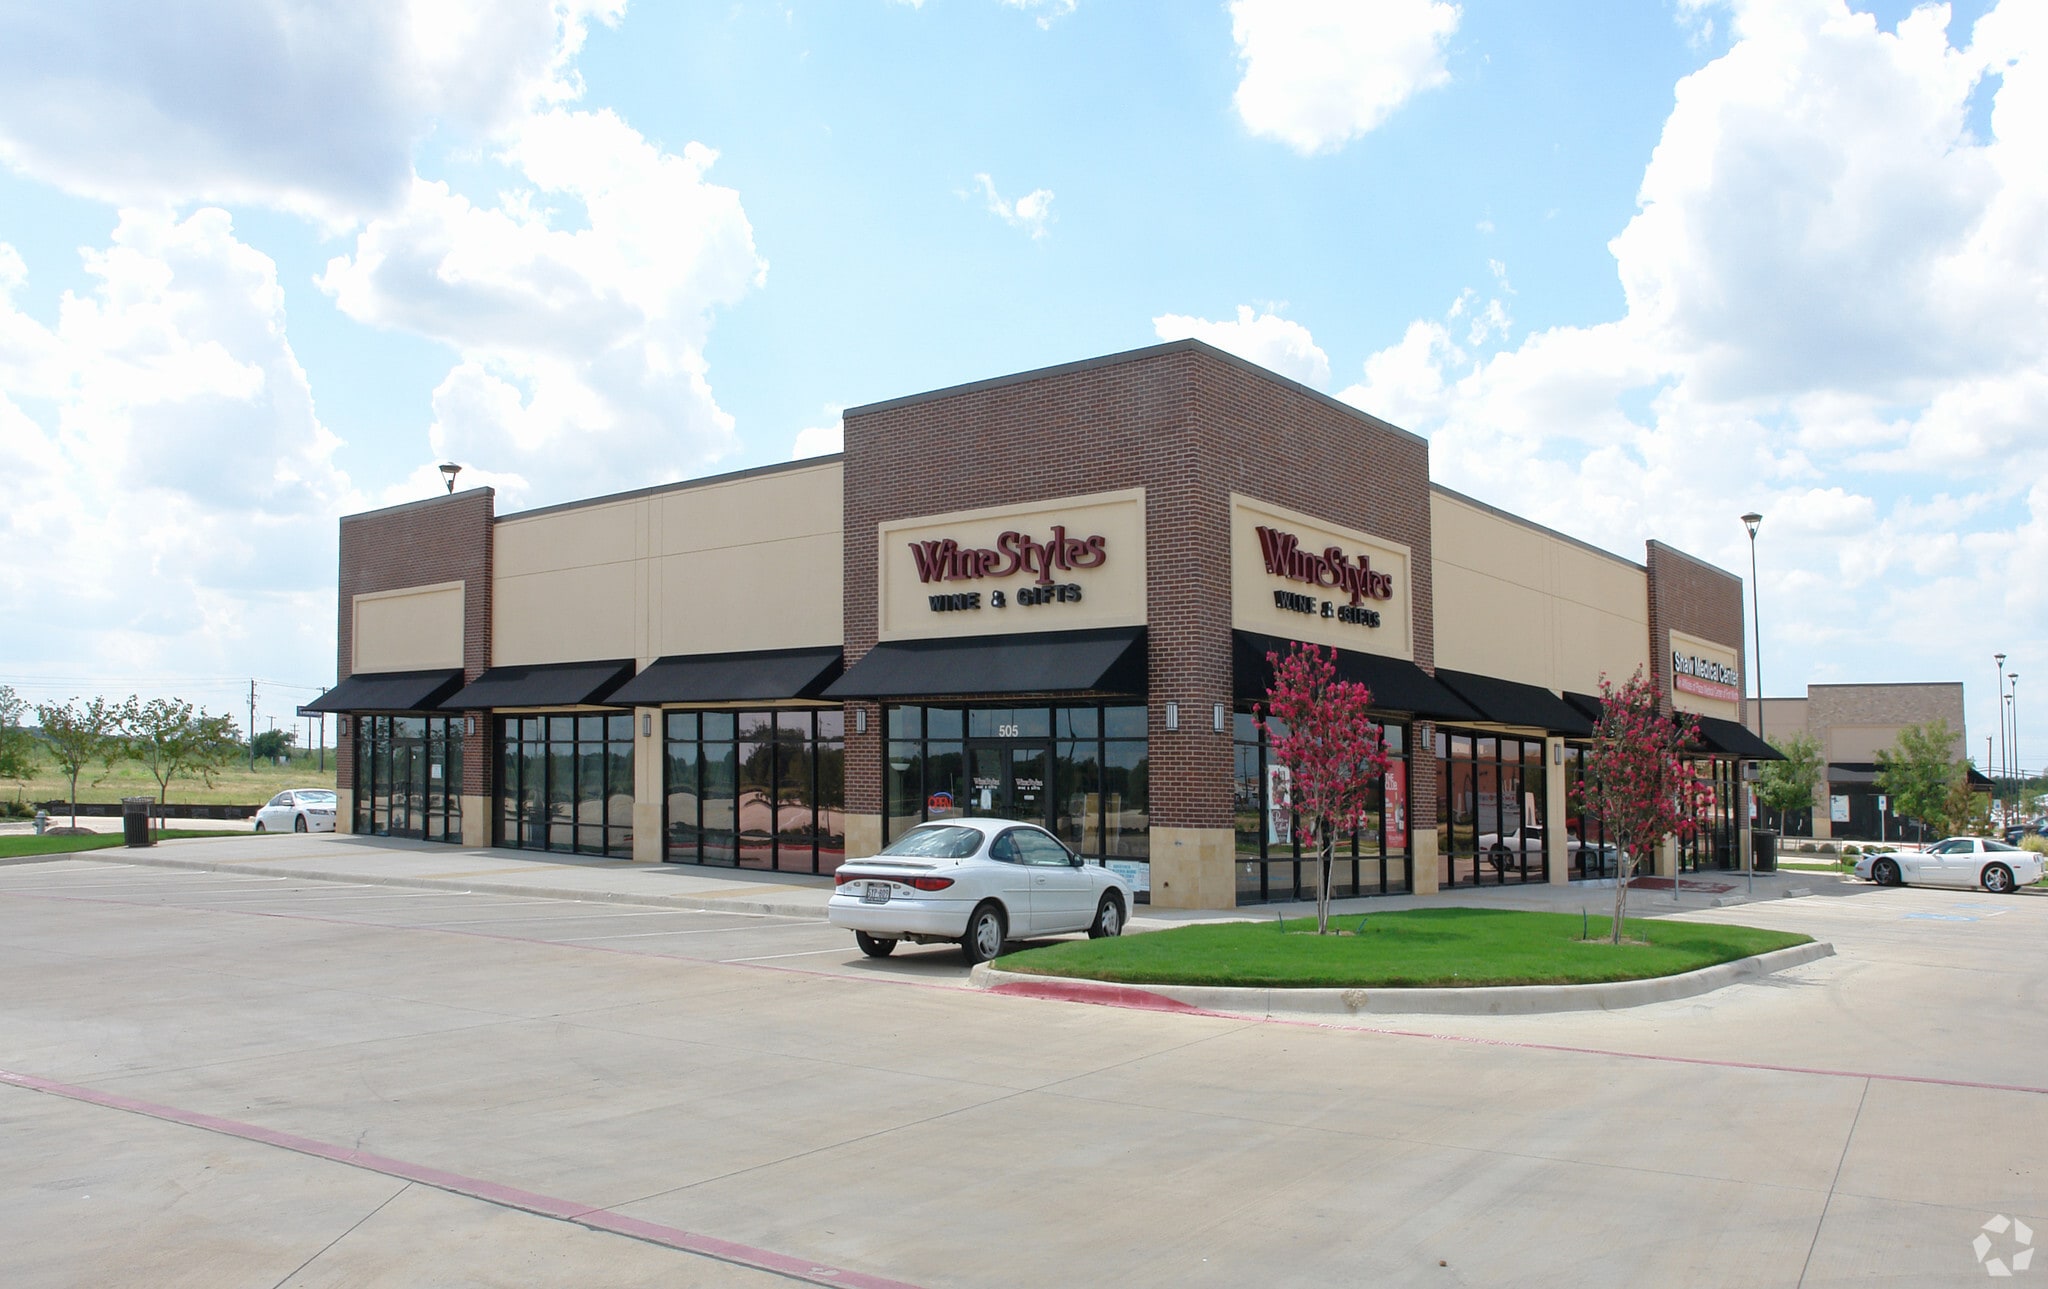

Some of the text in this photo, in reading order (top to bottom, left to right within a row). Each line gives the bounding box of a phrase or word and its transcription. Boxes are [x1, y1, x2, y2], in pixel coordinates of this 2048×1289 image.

[908, 525, 1106, 584] WineStyles
[1255, 526, 1393, 606] WineStyles
[928, 583, 1082, 612] WINE & GIFTS
[1273, 590, 1380, 628] WINE & GIFTS
[1673, 651, 1738, 687] Shaw Medical Center
[998, 725, 1018, 737] 505
[928, 796, 952, 811] OPEN
